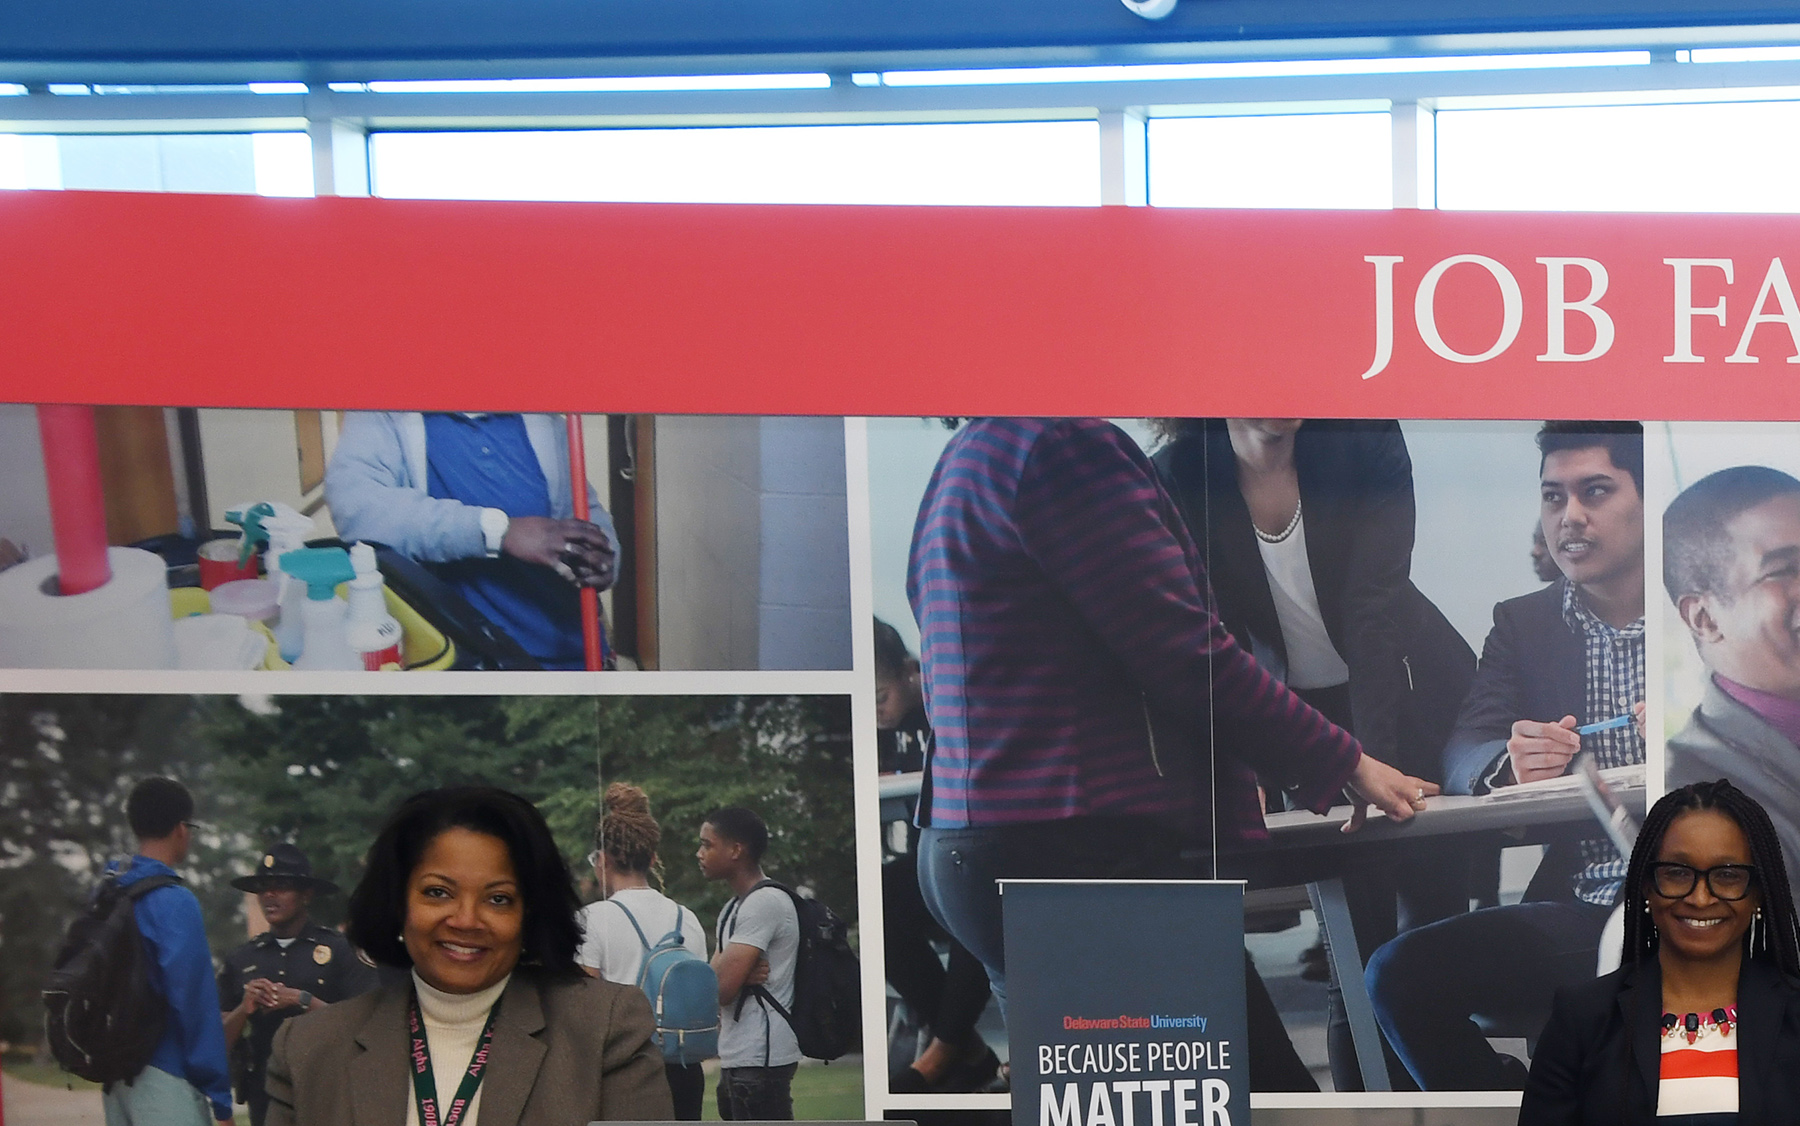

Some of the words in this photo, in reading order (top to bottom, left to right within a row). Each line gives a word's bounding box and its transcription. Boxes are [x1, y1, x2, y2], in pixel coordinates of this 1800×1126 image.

[1361, 253, 1615, 380] JOB
[1063, 1016, 1118, 1030] Delaware
[1119, 1015, 1149, 1029] State
[1150, 1014, 1207, 1033] University
[412, 1038, 428, 1074] Alpha
[468, 1043, 491, 1077] Alpha
[1038, 1043, 1141, 1075] BECAUSE
[1147, 1041, 1231, 1071] PEOPLE
